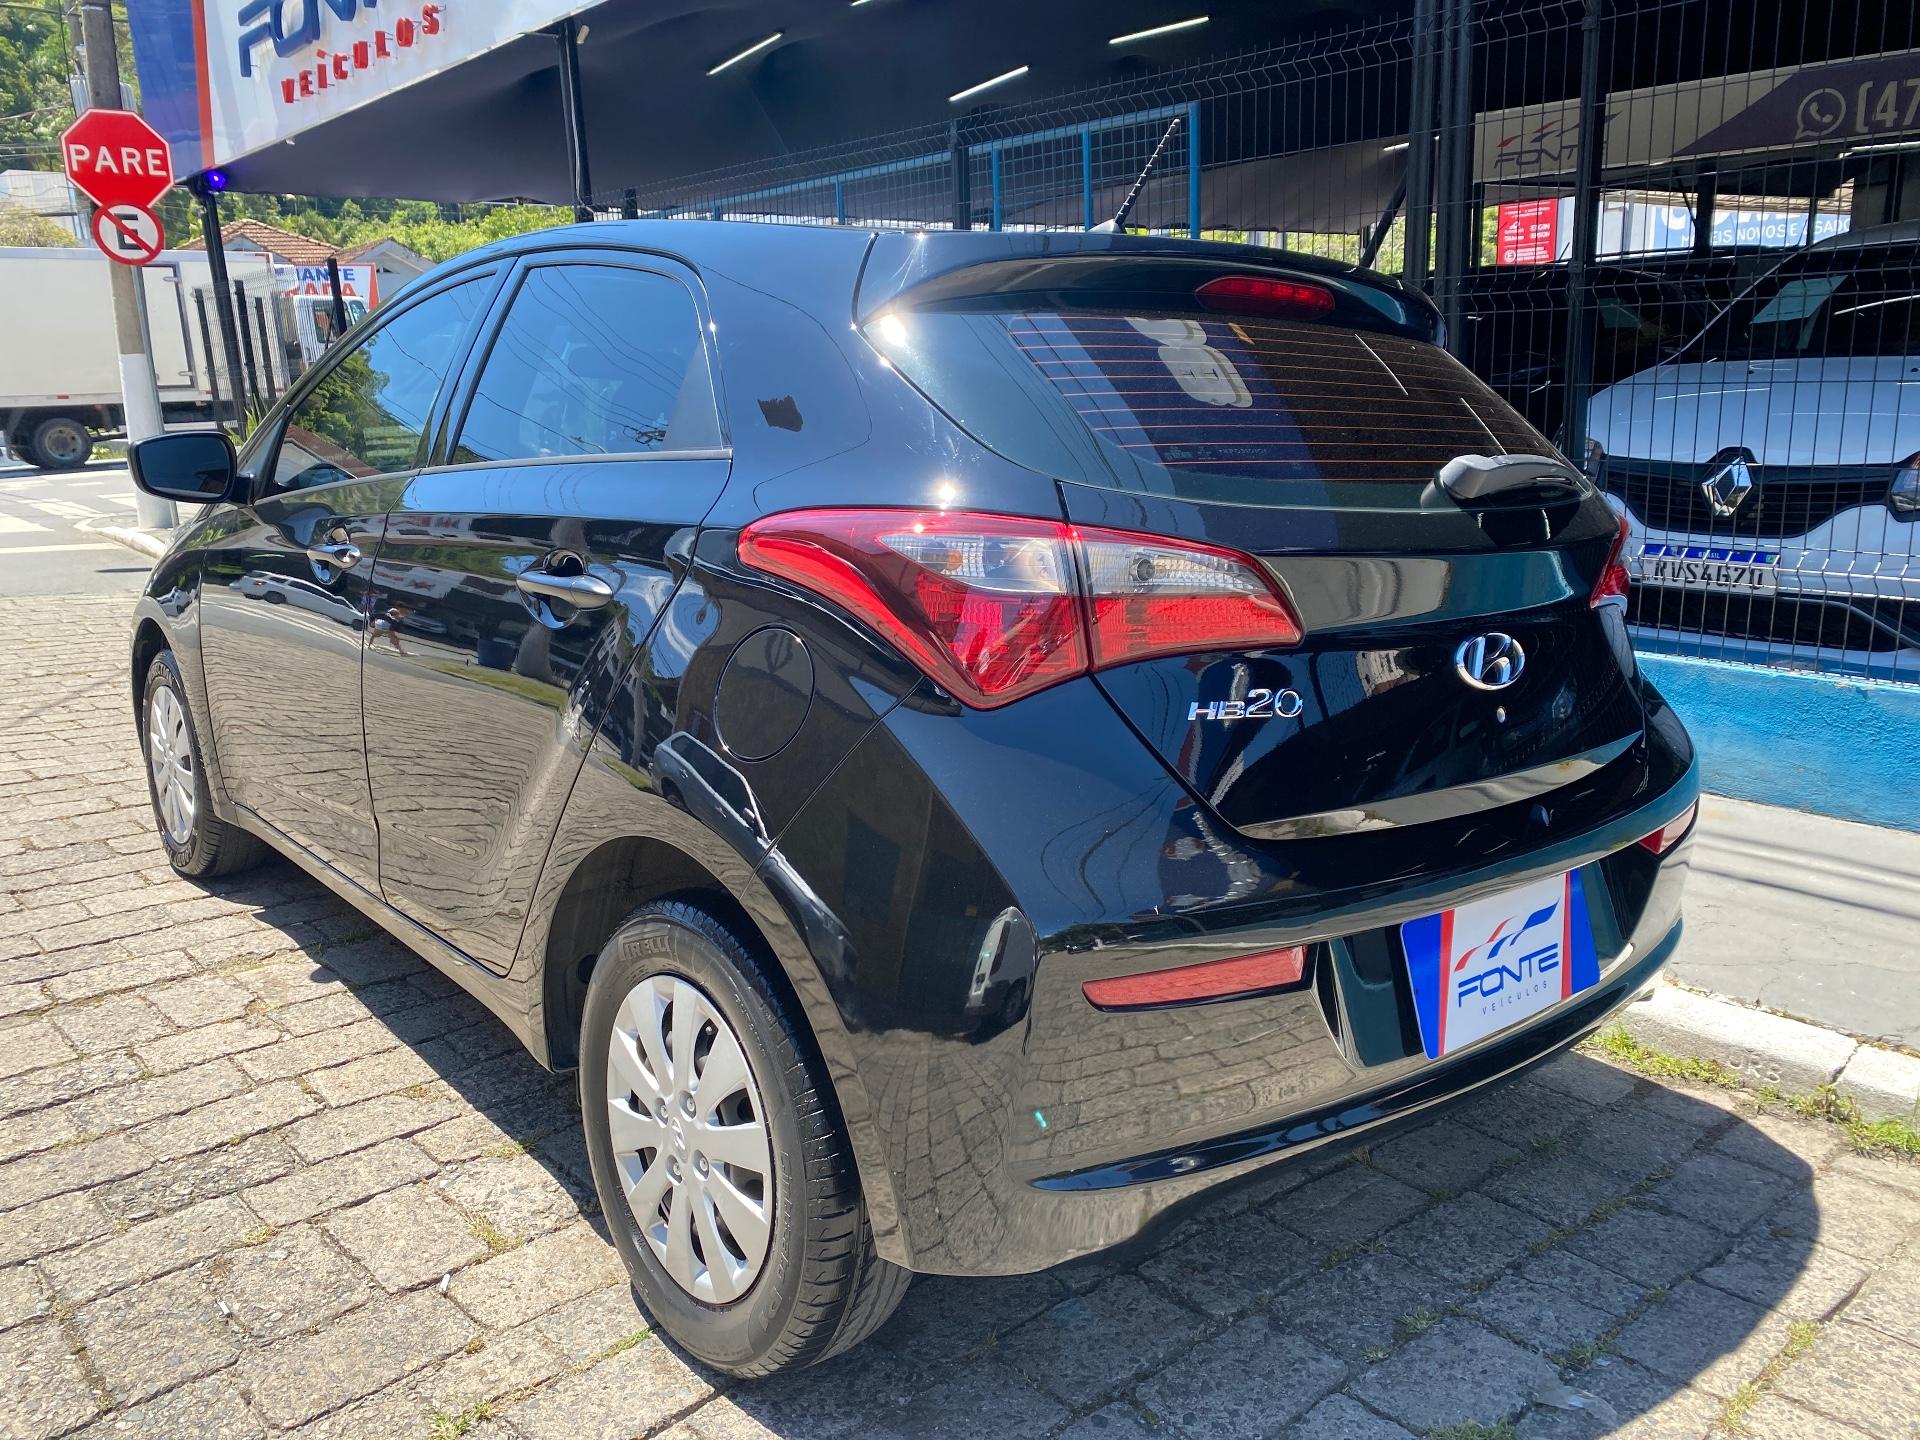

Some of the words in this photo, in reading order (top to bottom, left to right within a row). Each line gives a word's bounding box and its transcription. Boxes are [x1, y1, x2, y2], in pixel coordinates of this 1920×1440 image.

[69, 144, 167, 176] PARE
[1493, 141, 1607, 169] FONT
[114, 213, 143, 250] E
[1681, 229, 1732, 247] MEIS
[1736, 224, 1786, 243] NOVOS
[1790, 222, 1798, 236] E
[1187, 688, 1303, 720] HB20
[618, 928, 677, 960] PIRELLI
[1458, 942, 1559, 1008] FONTE
